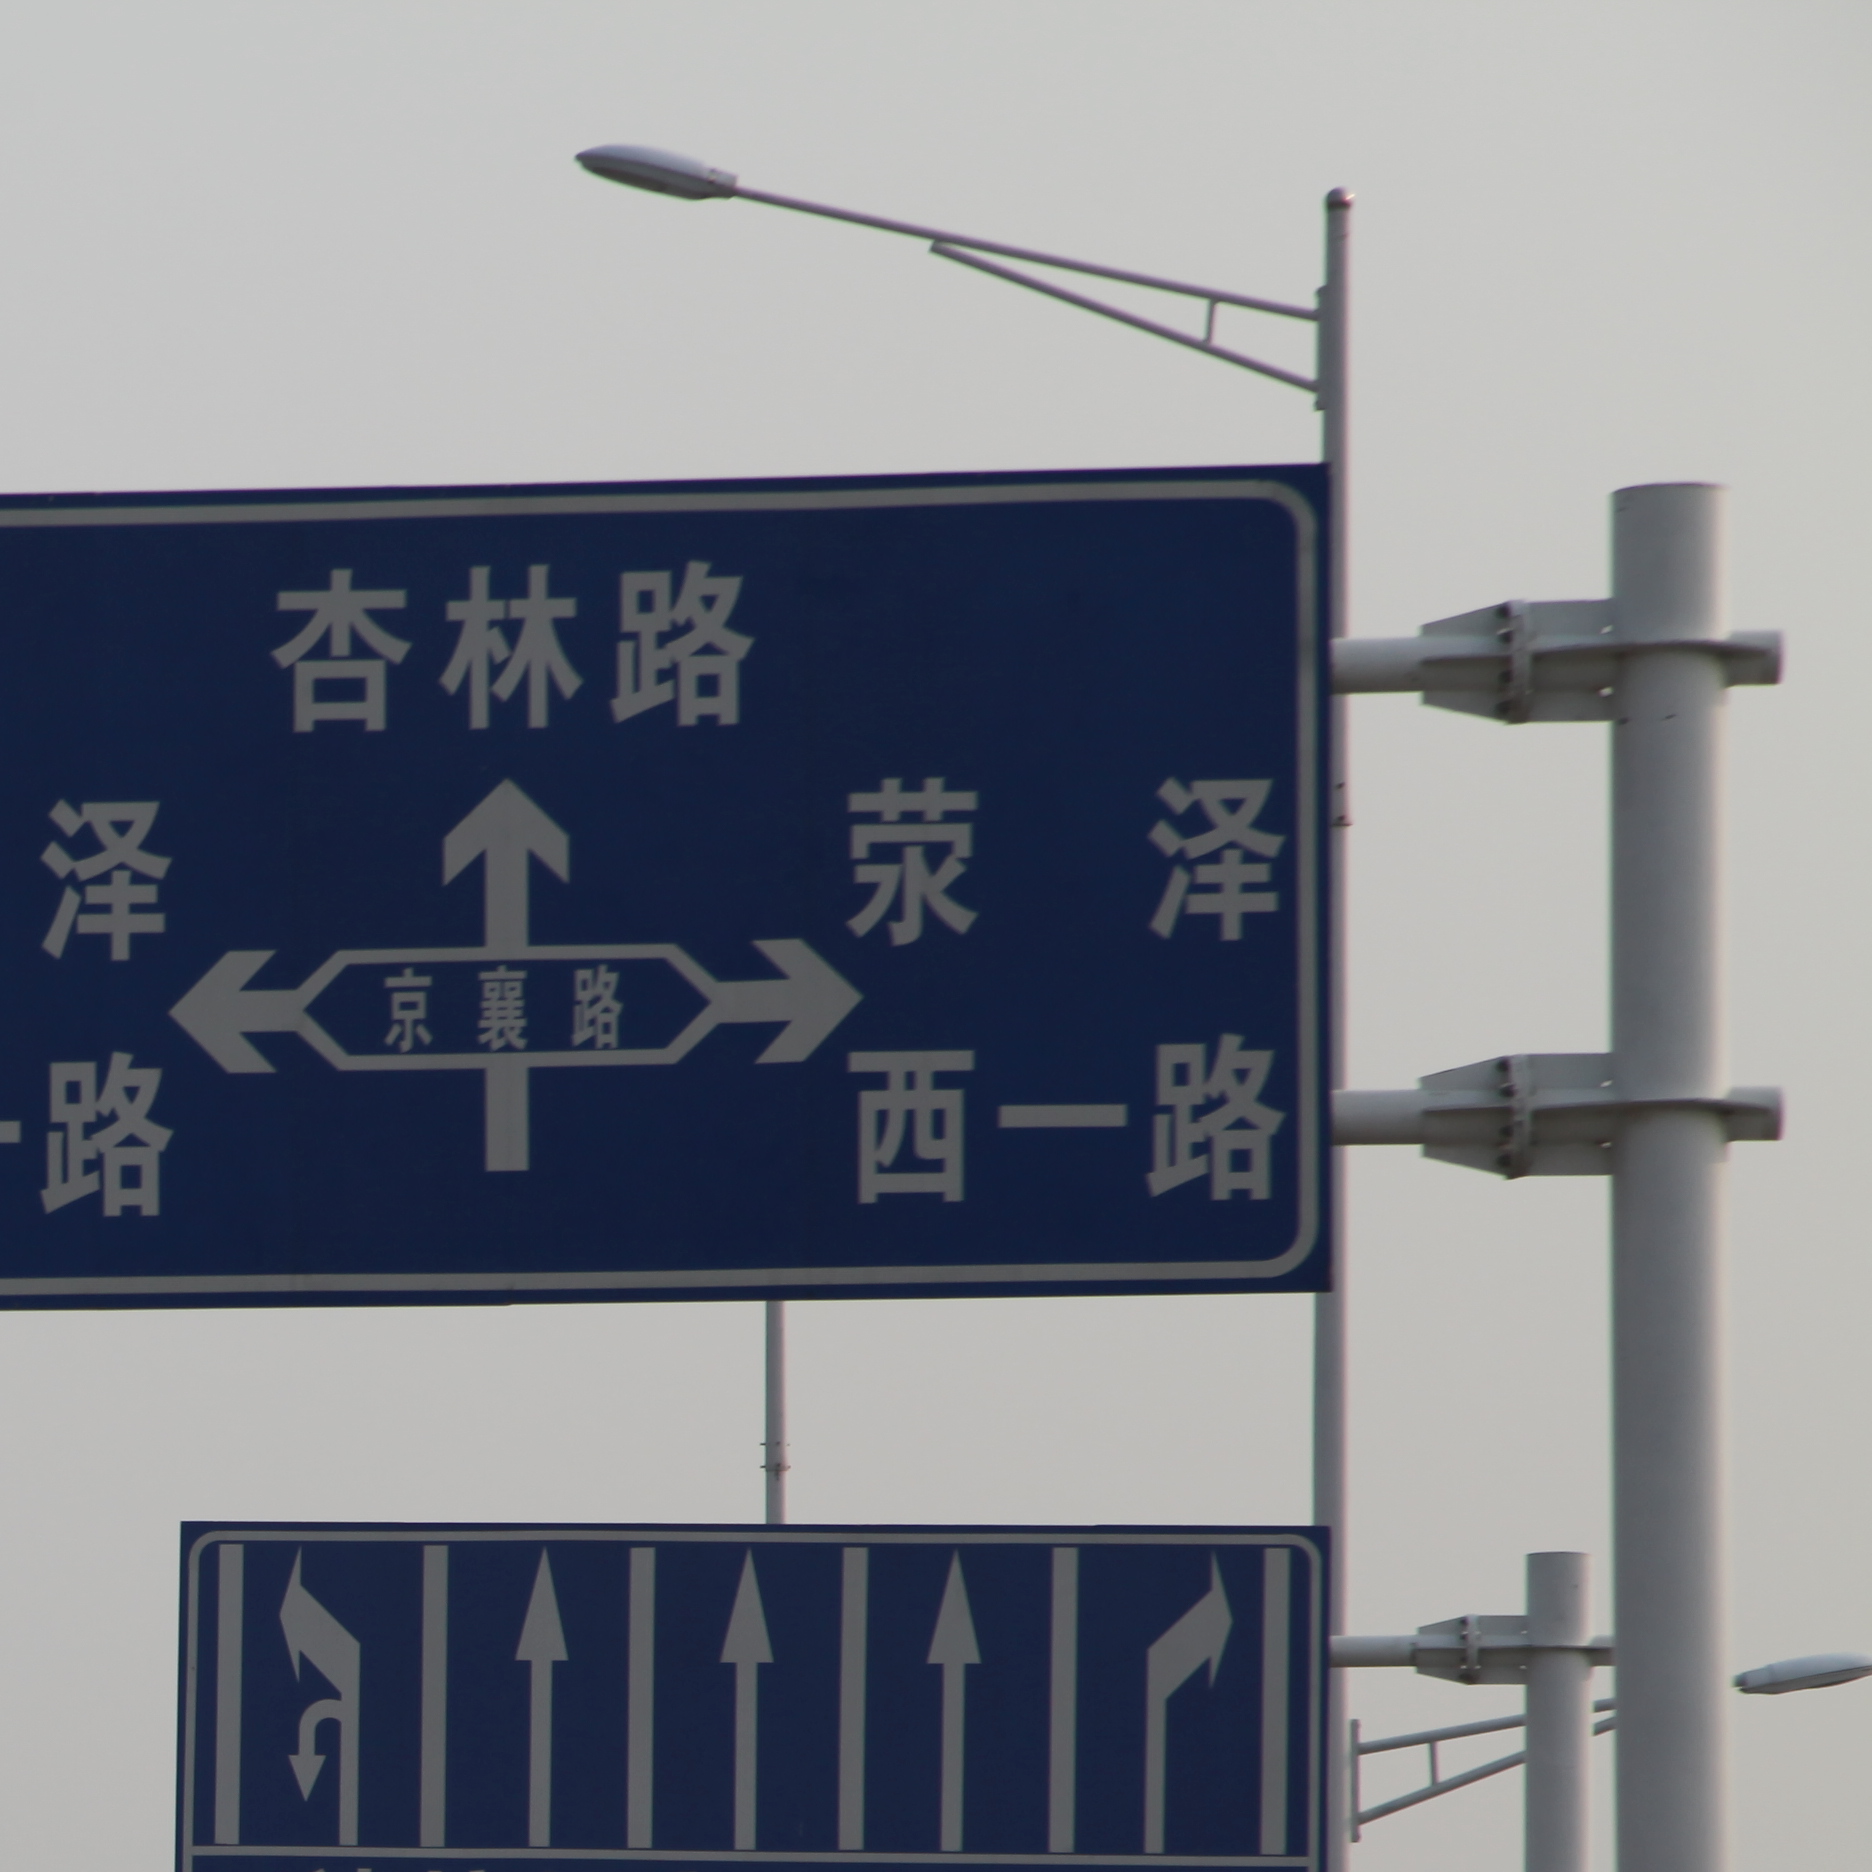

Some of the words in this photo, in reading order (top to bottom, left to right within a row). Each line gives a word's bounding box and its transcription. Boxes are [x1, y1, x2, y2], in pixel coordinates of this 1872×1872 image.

[269, 559, 755, 734] 杏林路
[846, 775, 1287, 948] 荥泽
[383, 963, 624, 1054] 京襄路
[848, 1033, 1287, 1205] 西一路
